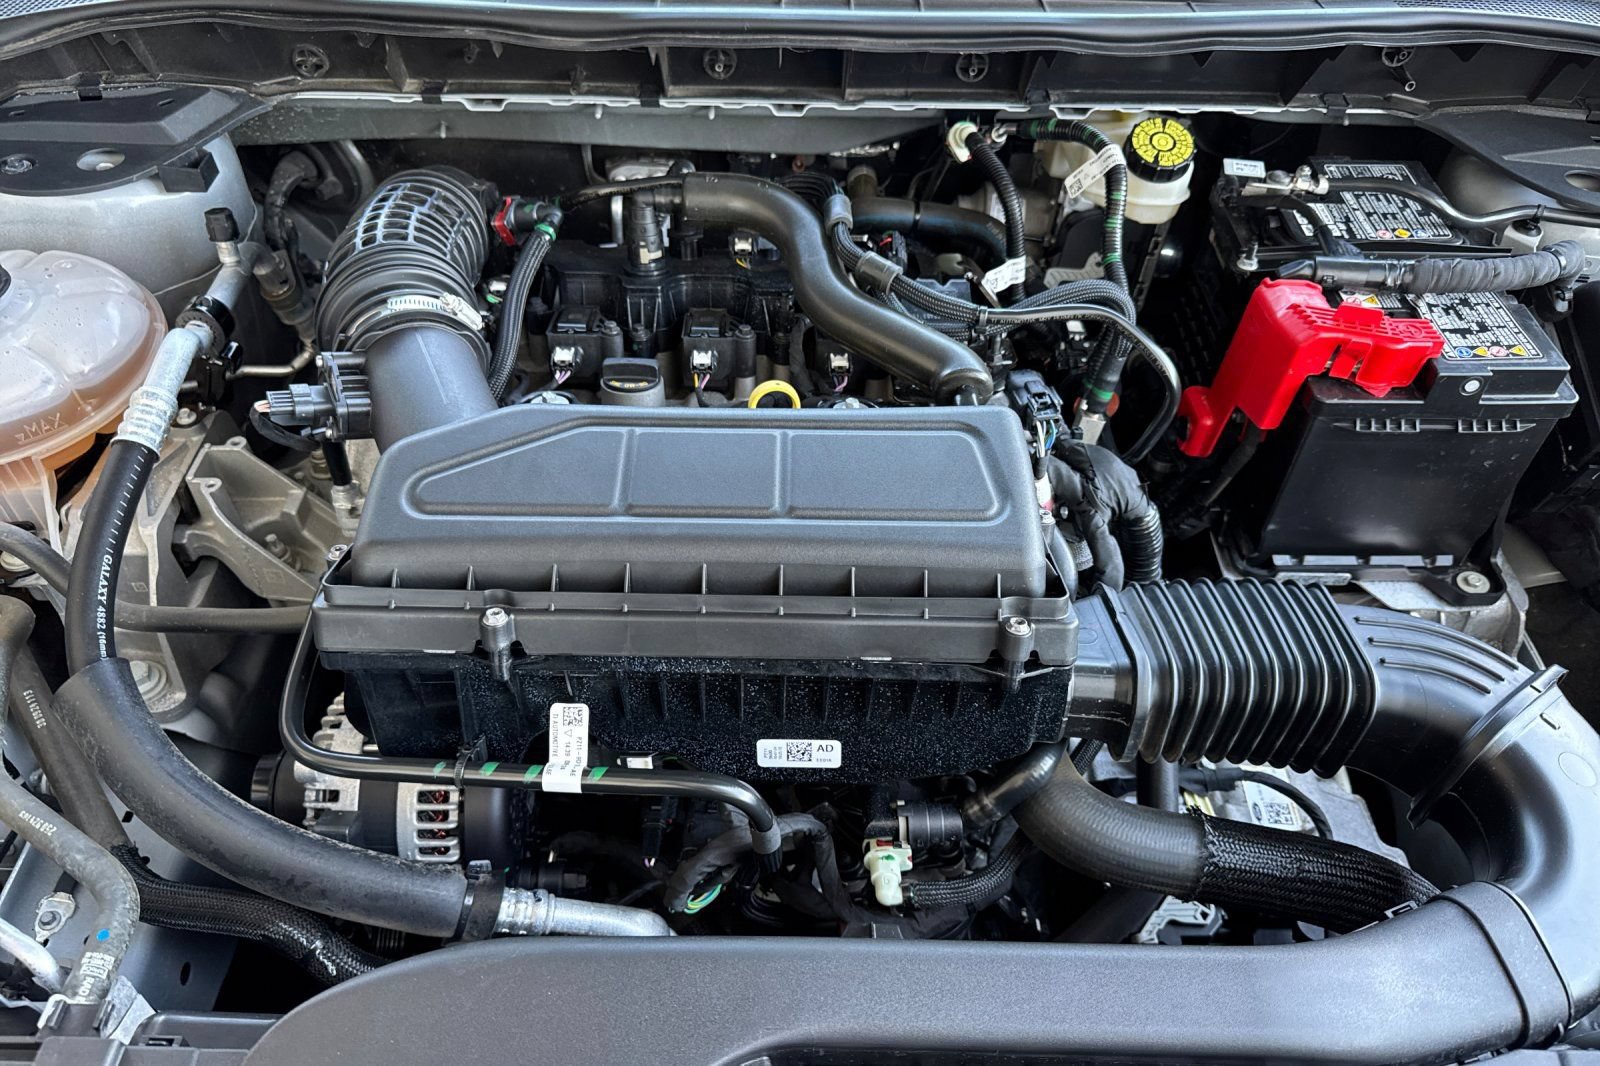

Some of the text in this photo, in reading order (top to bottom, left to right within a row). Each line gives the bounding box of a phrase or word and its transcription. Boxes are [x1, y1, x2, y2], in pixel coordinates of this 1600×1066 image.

[23, 412, 67, 438] MAX
[98, 555, 113, 605] GALAXY
[97, 605, 106, 630] 4882
[816, 744, 834, 753] AD
